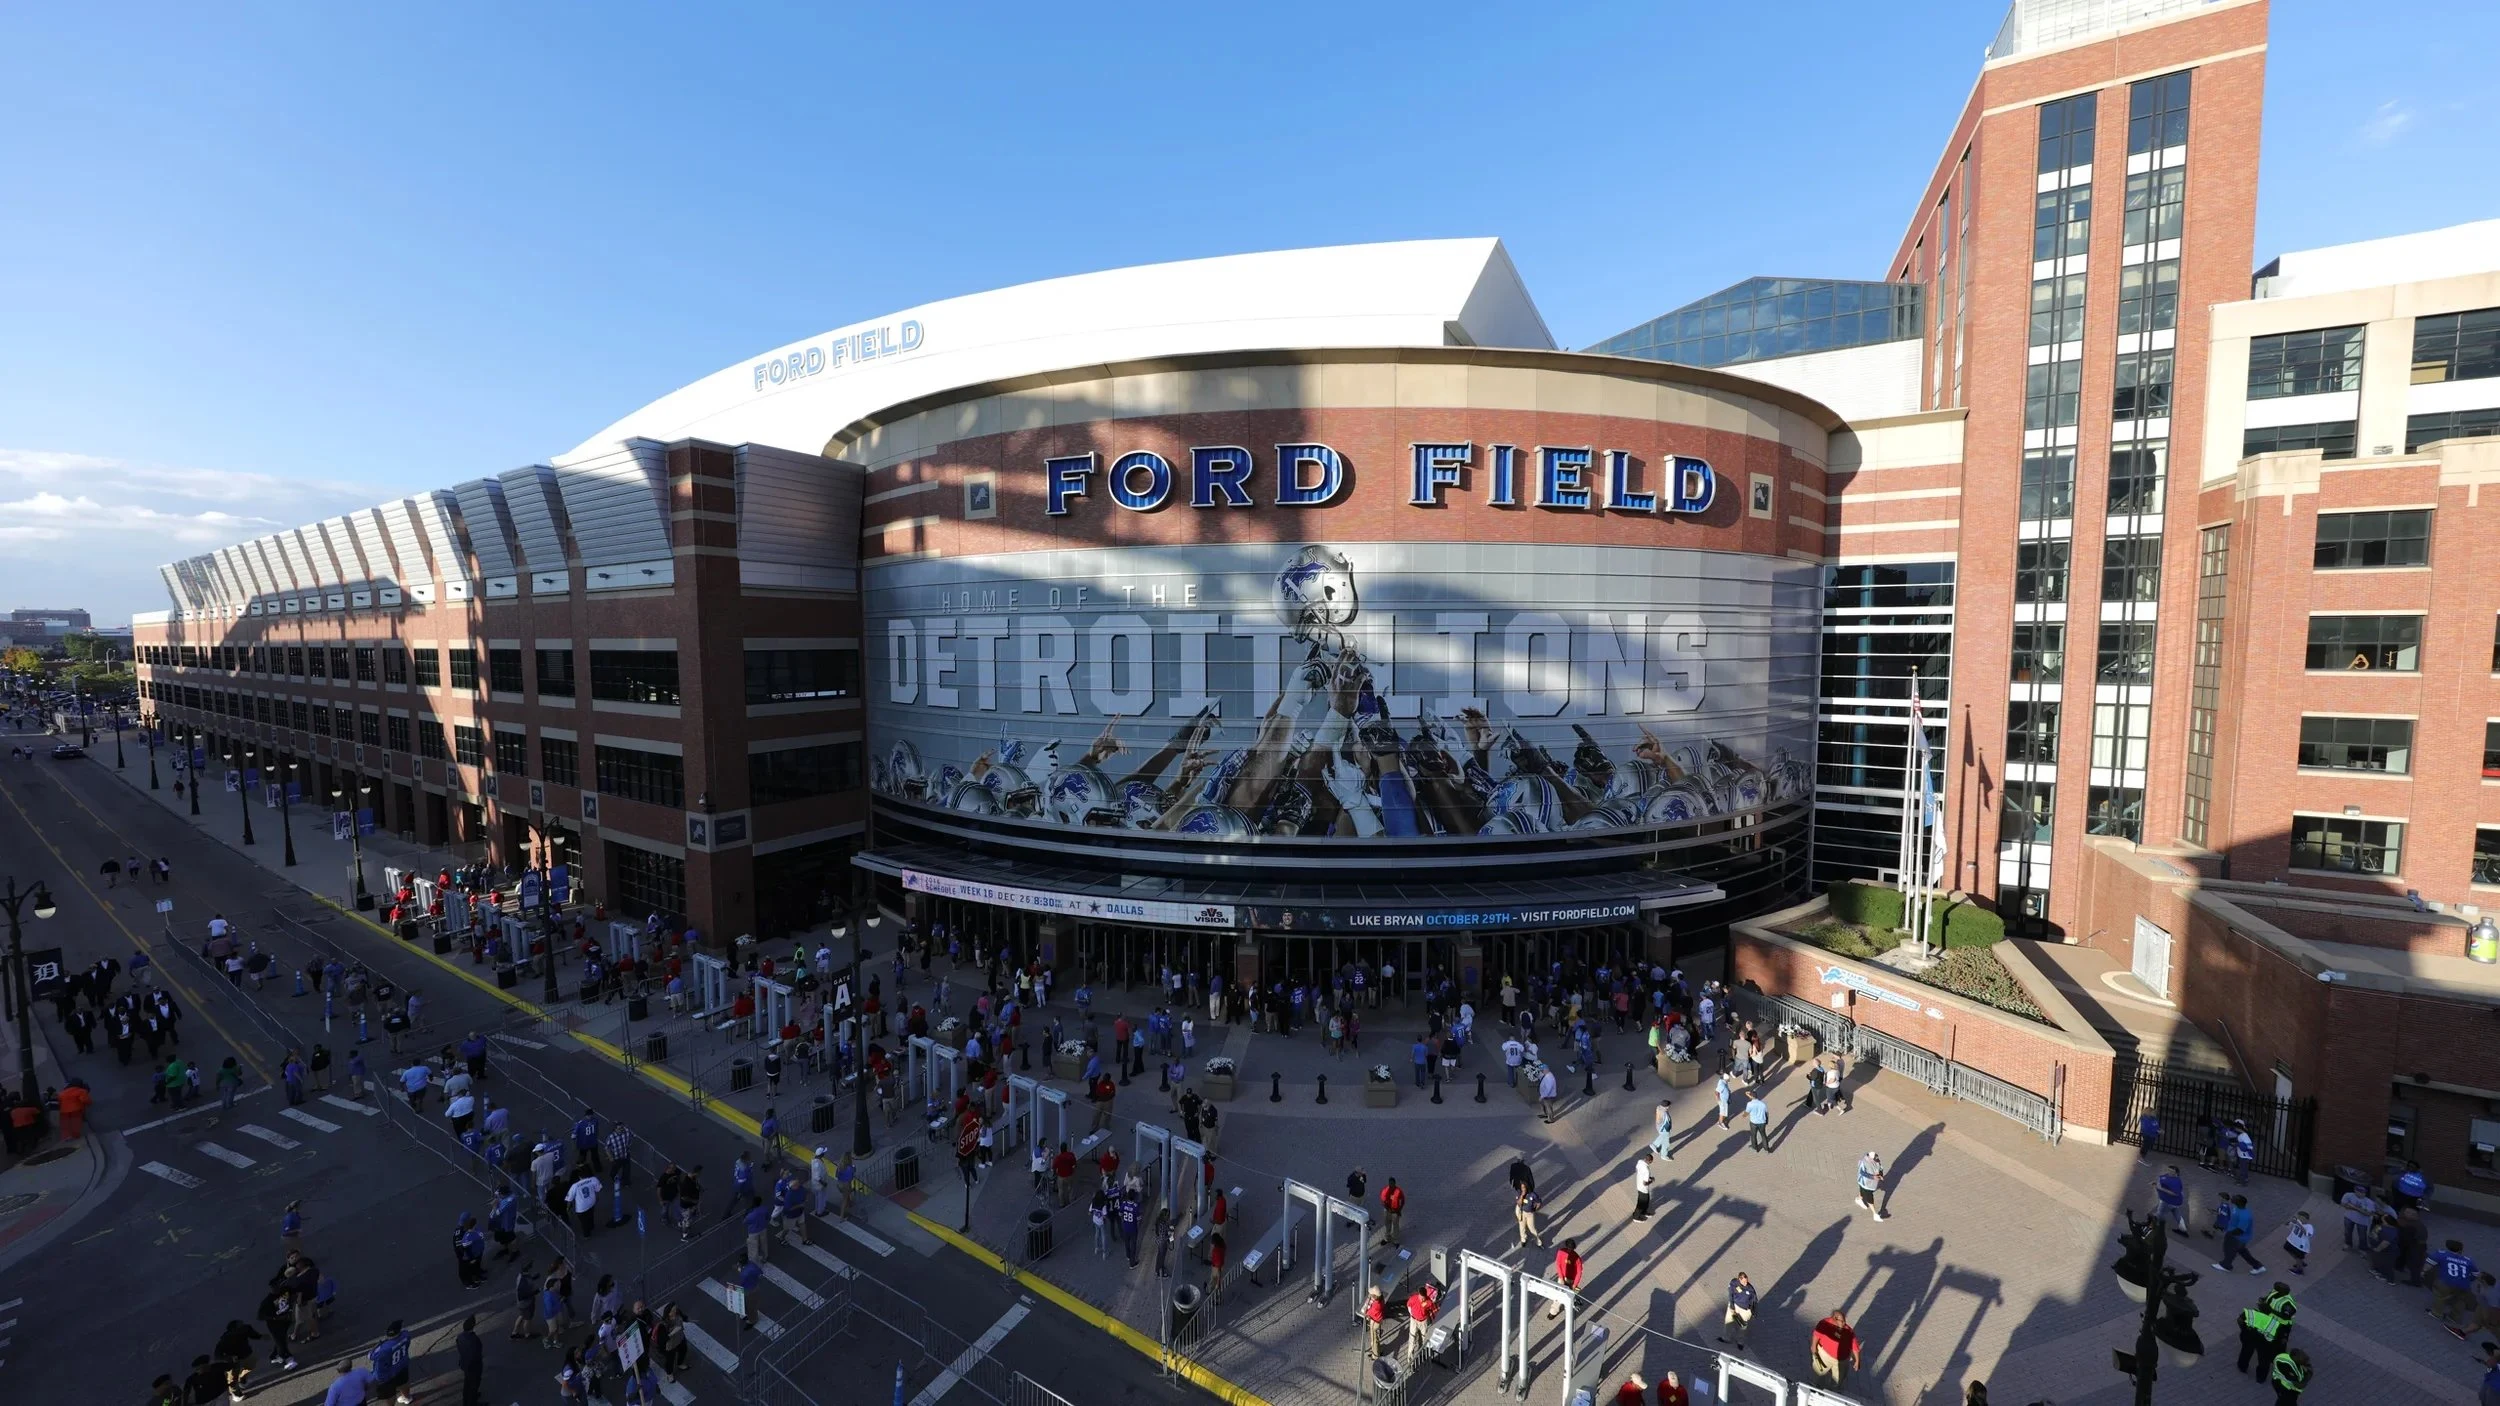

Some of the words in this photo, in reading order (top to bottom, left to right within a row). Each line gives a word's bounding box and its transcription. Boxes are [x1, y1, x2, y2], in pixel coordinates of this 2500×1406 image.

[753, 345, 825, 392] FORD
[832, 319, 925, 369] FIELD
[1043, 441, 1344, 515] FORD
[1408, 440, 1717, 514] FIELD
[942, 587, 1019, 614] HOME
[1048, 585, 1088, 611] OF
[1121, 583, 1198, 609] THE
[887, 613, 1296, 718] DETROIT
[1365, 612, 1708, 719] LIONS
[925, 883, 957, 896] SCHEDULE
[960, 885, 981, 897] WEEK
[983, 888, 994, 899] 16
[997, 892, 1016, 902] DEC
[1019, 894, 1031, 904] 26
[1033, 896, 1055, 907] 8:30
[1069, 901, 1081, 910] AT
[1107, 903, 1144, 916] DALLAS
[1194, 916, 1229, 924] VISION
[1350, 915, 1381, 926] LUKE
[1384, 915, 1424, 926] BRYAN
[1426, 914, 1479, 925] OCTOBER
[1482, 912, 1510, 924] 29TH
[1520, 911, 1550, 922] VISIT
[1552, 905, 1635, 921] FORDFIELD.COM
[833, 974, 851, 986] GATE
[834, 983, 852, 1011] A
[585, 1125, 595, 1136] 81
[960, 1127, 979, 1149] STOP
[1123, 1211, 1134, 1222] 28
[2447, 1262, 2467, 1278] 81
[391, 1344, 406, 1366] 81
